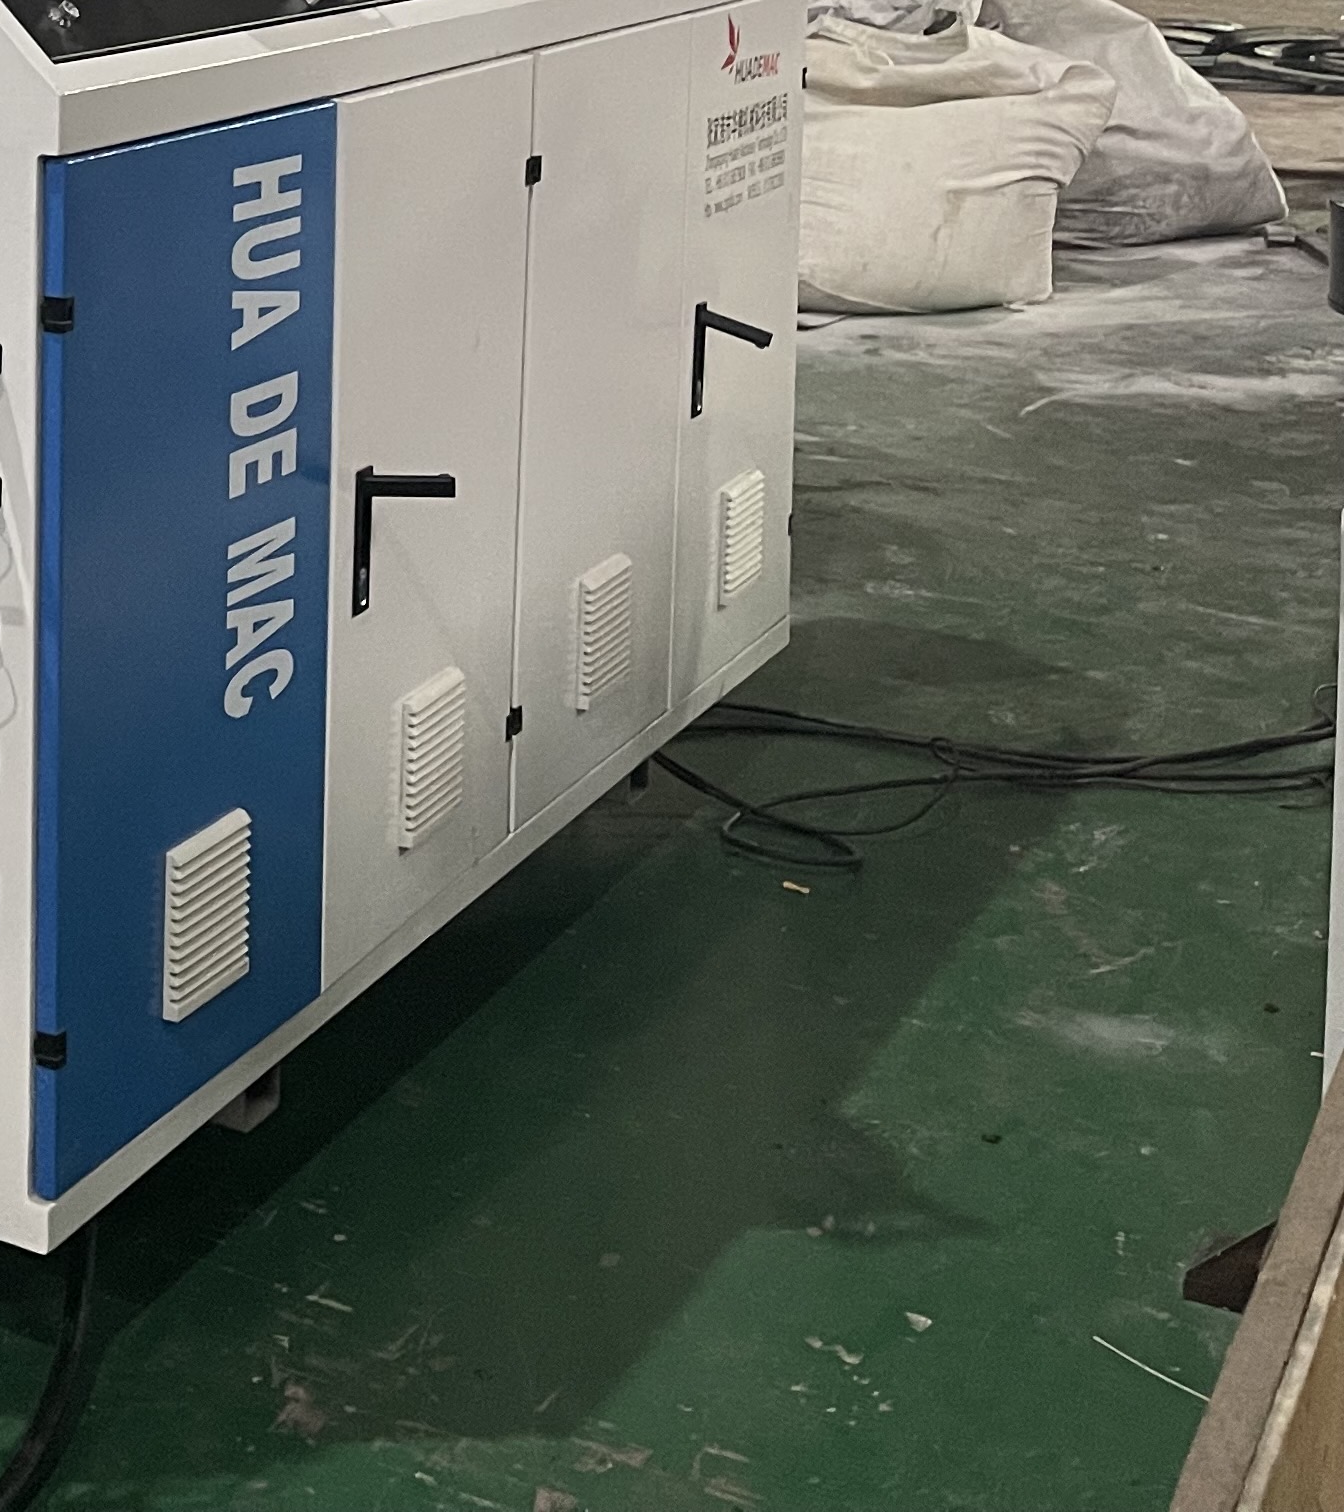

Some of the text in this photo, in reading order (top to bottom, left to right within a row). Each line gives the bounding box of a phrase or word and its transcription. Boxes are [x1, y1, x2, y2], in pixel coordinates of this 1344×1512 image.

[223, 154, 302, 719] HUA DE MAC
